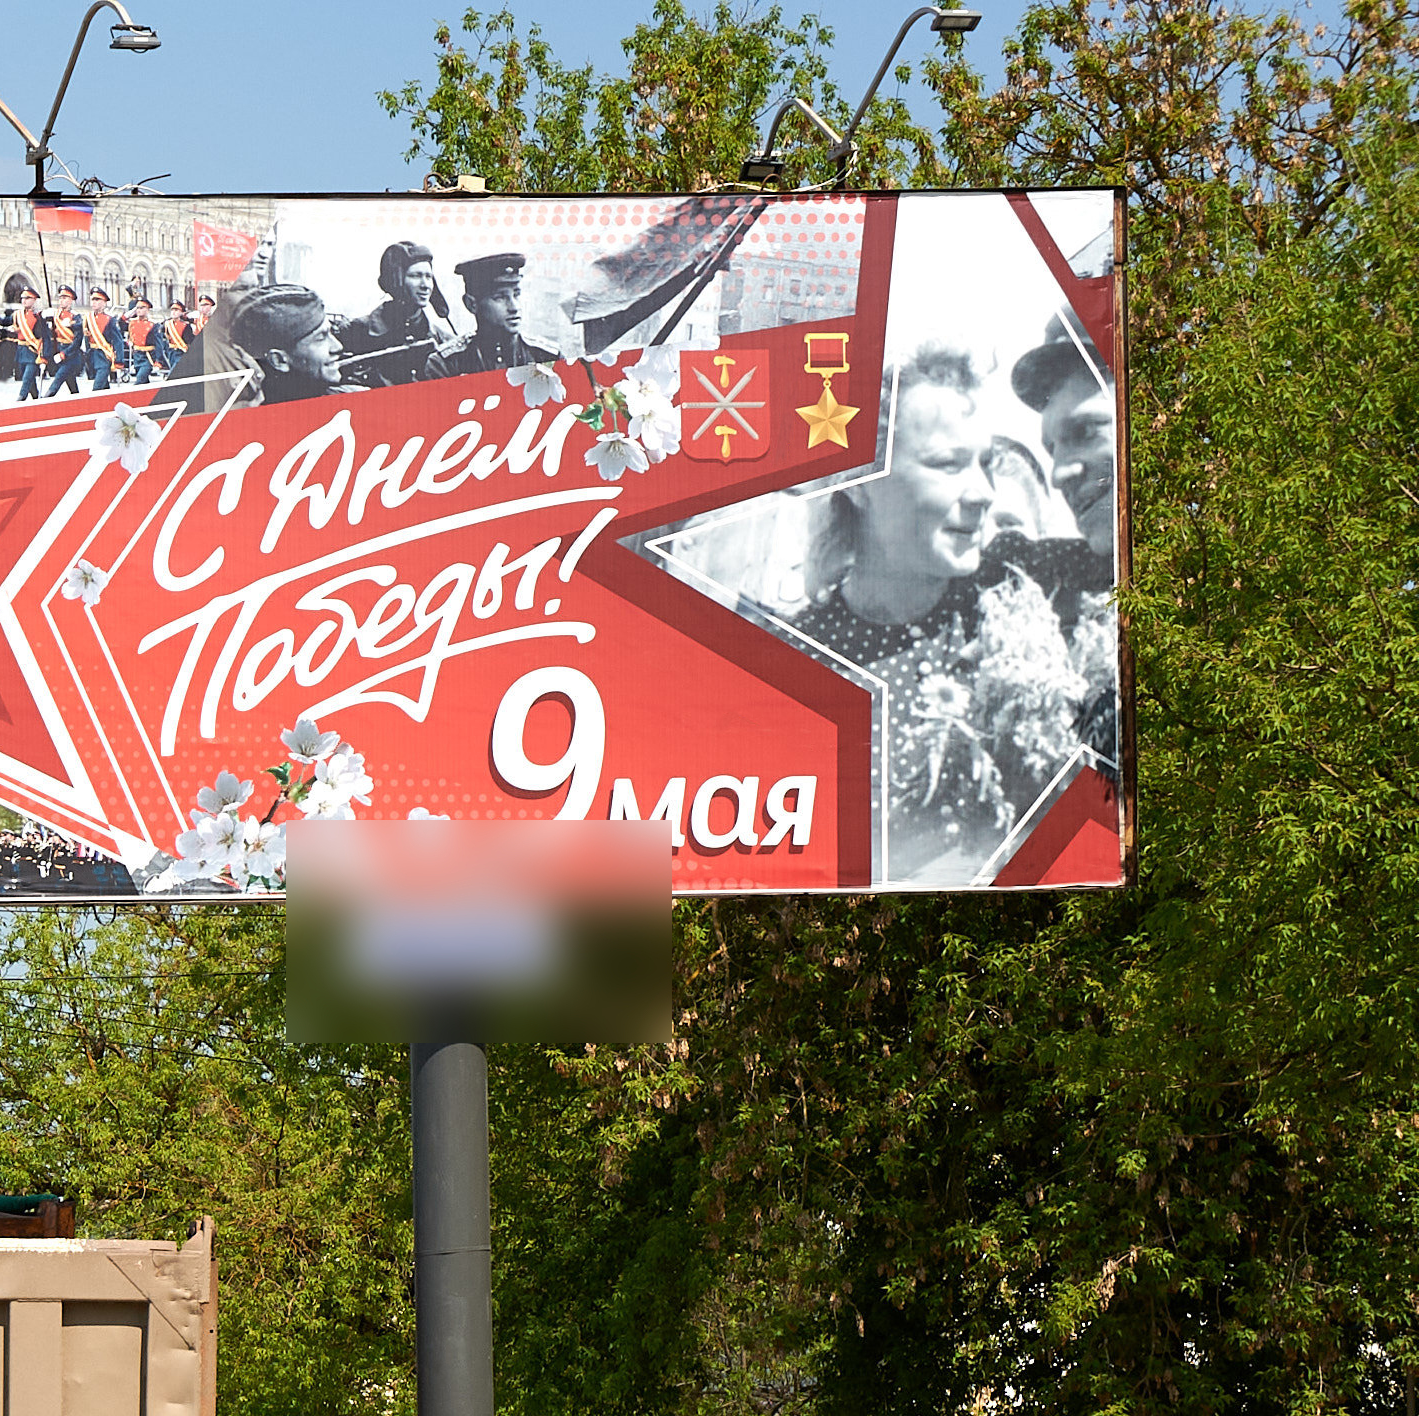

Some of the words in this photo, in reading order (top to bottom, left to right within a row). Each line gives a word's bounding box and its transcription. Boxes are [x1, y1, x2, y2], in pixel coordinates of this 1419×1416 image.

[152, 440, 265, 592] С
[259, 394, 583, 554] Днём
[137, 486, 624, 758] Победы!
[488, 665, 606, 820] 9
[610, 774, 818, 850] мая
